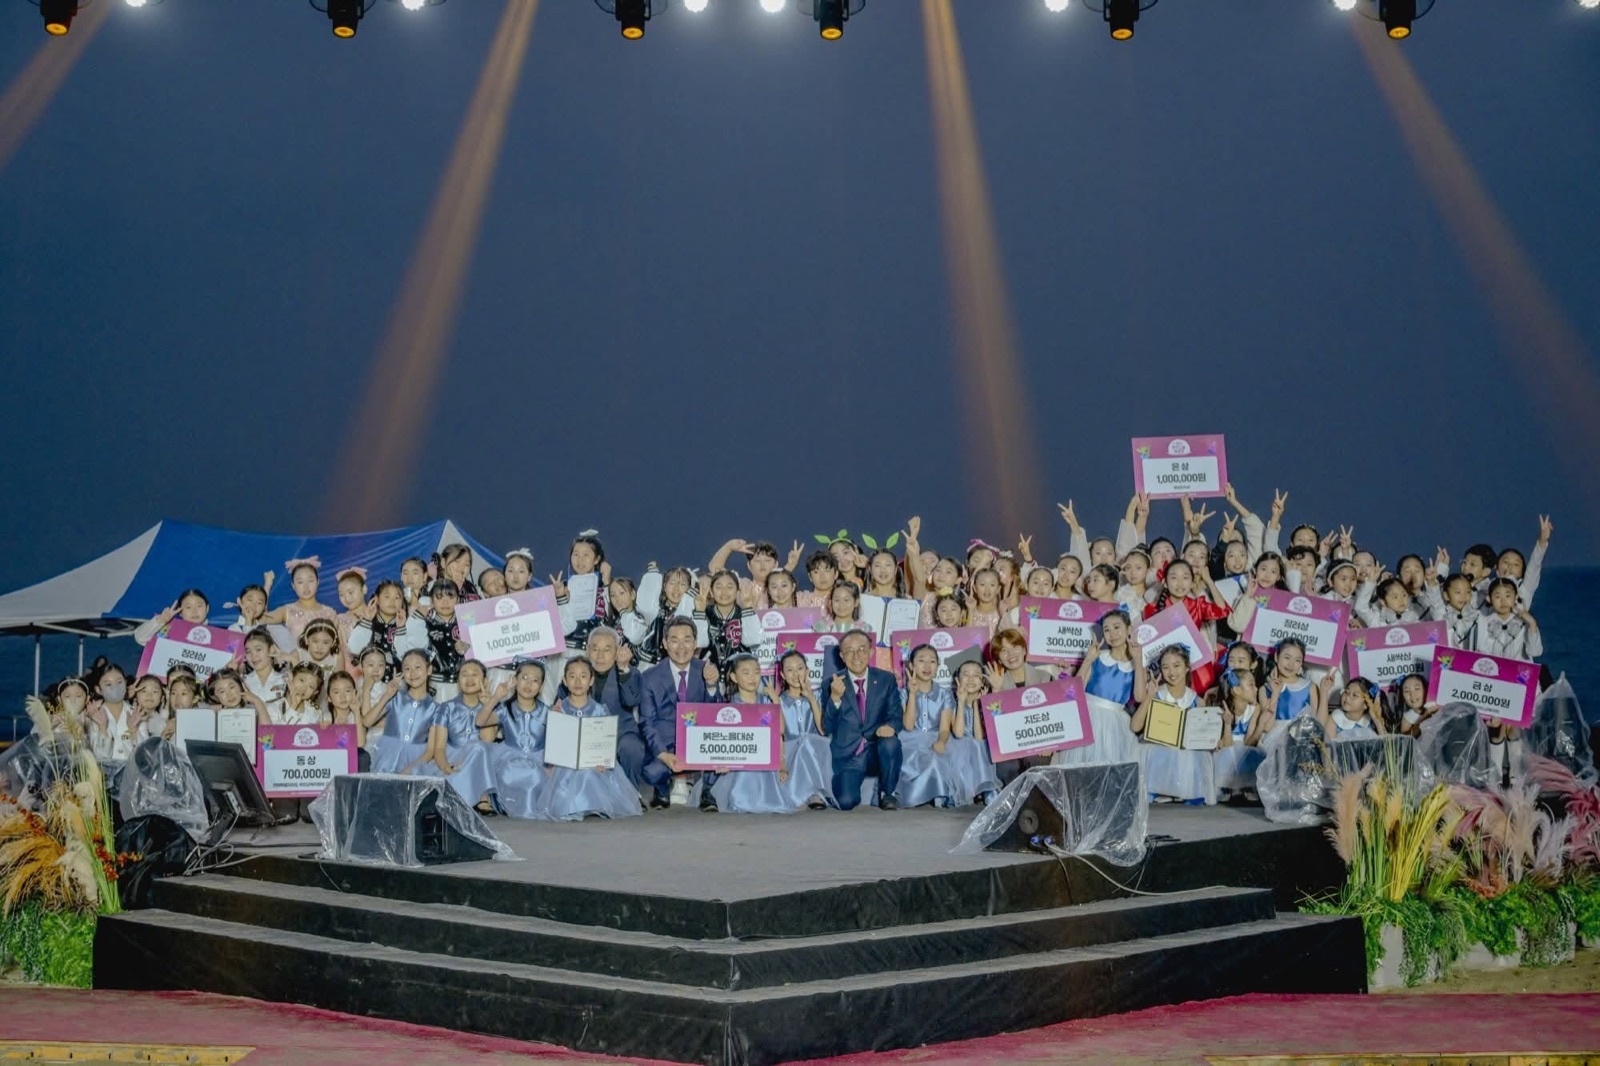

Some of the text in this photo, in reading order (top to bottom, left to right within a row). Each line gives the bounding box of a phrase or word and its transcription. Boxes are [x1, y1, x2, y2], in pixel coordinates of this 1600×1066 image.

[1156, 472, 1207, 485] 1,000,000원
[1057, 626, 1083, 636] 새싹상
[1284, 618, 1310, 632] 장려상
[486, 630, 540, 651] 1,000,000원
[181, 648, 207, 662] 장려상
[1387, 652, 1412, 663] 새싹상
[1376, 662, 1425, 677] 300,000원
[1451, 688, 1511, 709] 2,000,000원
[1023, 711, 1051, 725] 지도상
[702, 731, 755, 742] 붉은노을대상
[1014, 721, 1065, 740] 500,000원
[699, 743, 758, 755] 5,000,000원
[296, 755, 317, 766] 동 상
[282, 768, 331, 780] 700,000원
